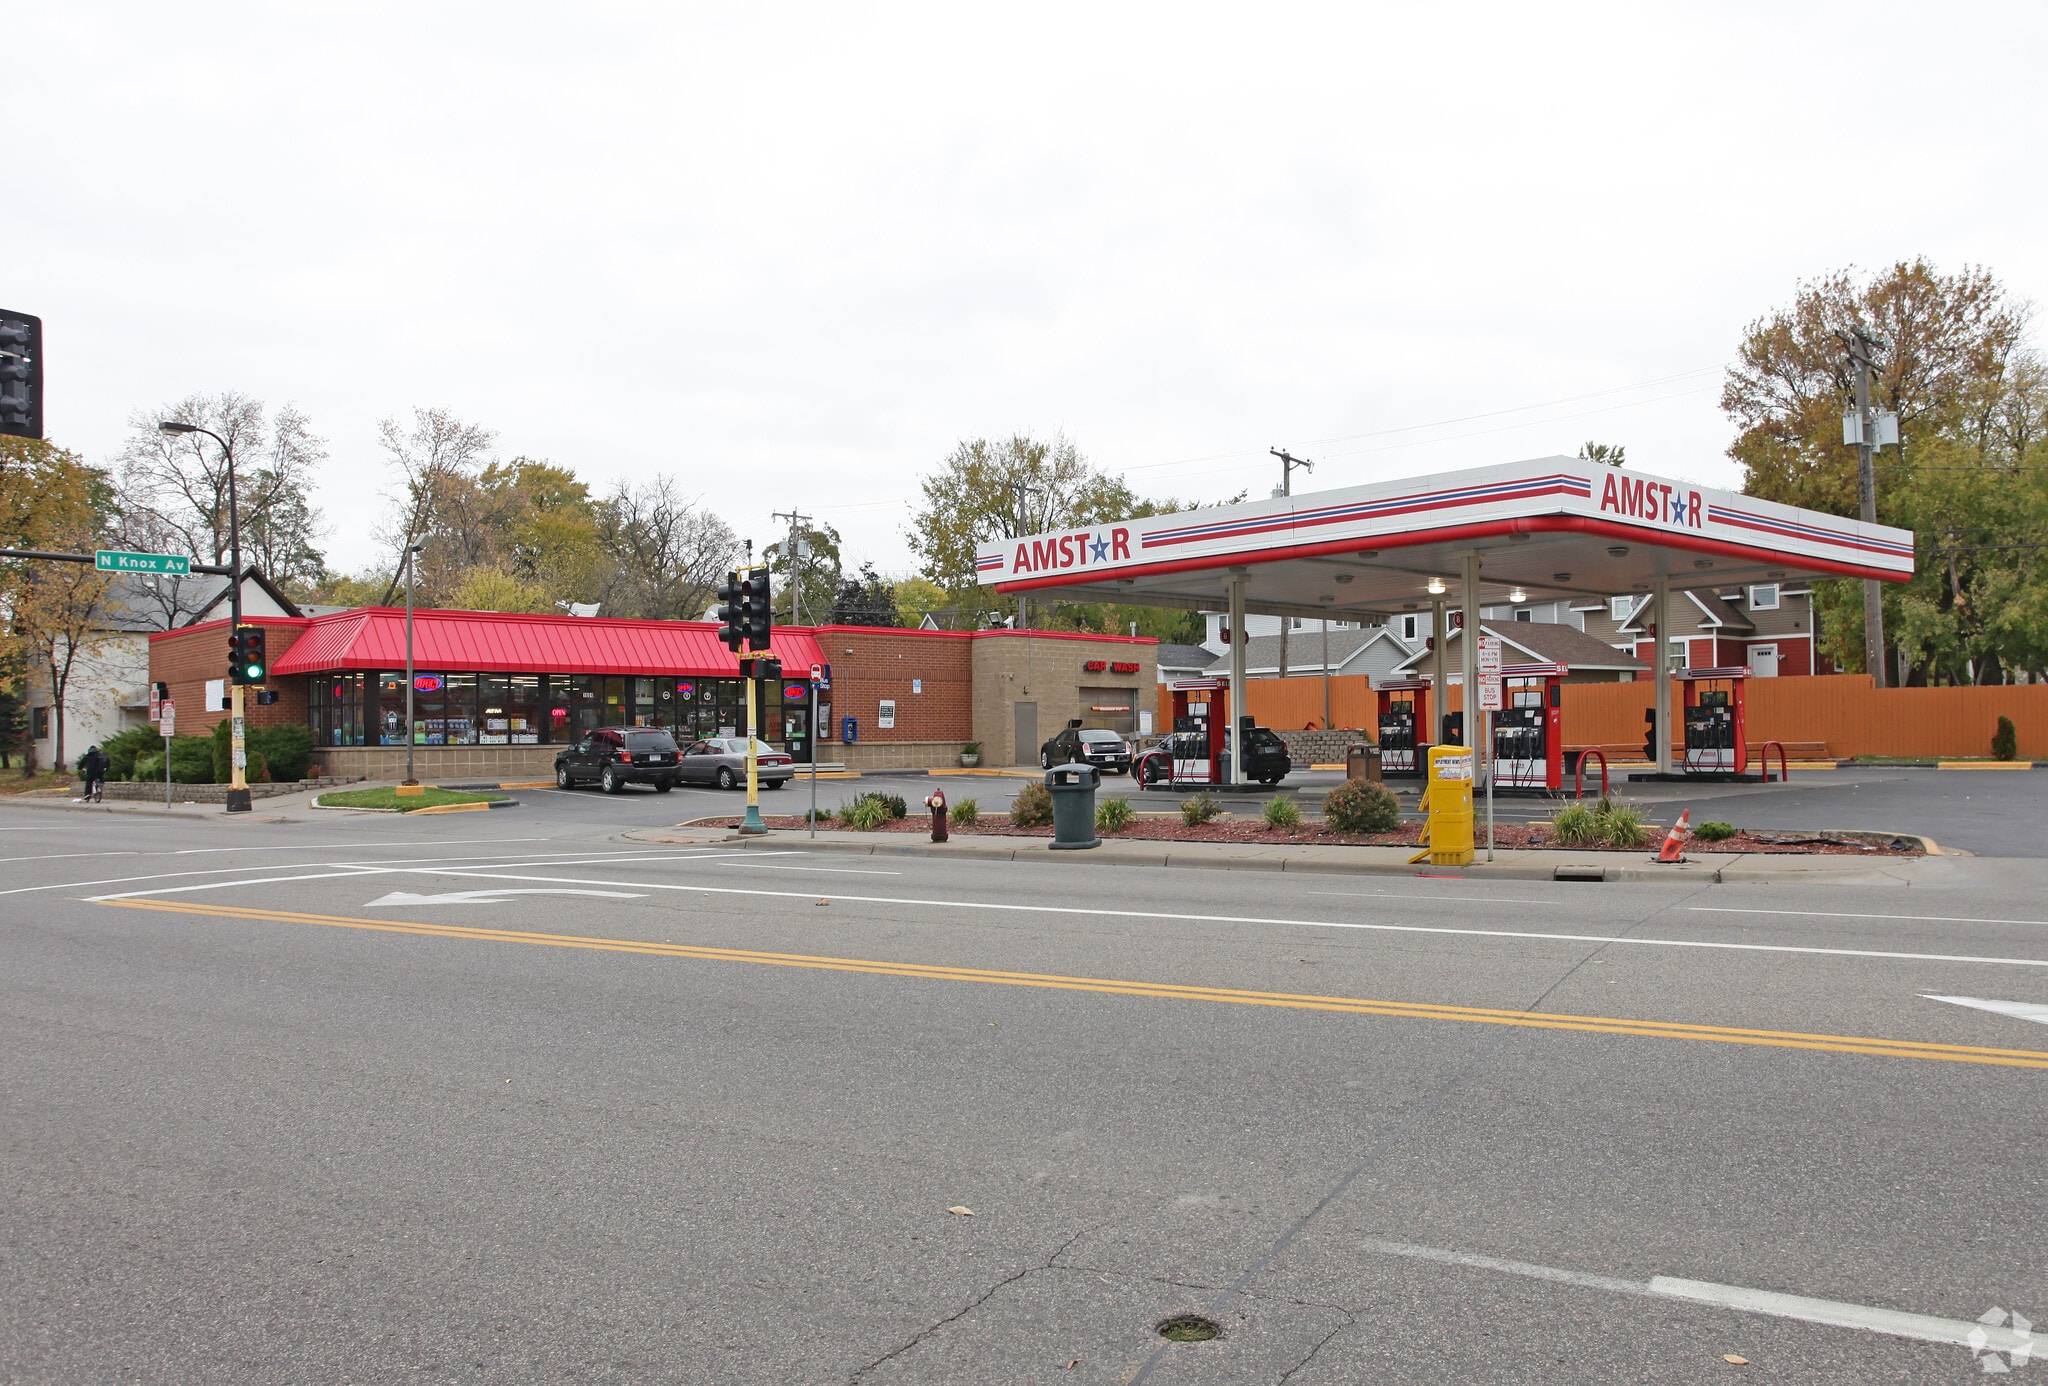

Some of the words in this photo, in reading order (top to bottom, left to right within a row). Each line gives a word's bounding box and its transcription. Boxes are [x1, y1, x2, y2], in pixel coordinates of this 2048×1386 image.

[101, 555, 111, 566] N
[119, 556, 157, 569] Knox
[165, 560, 184, 570] Av
[1087, 660, 1107, 671] CAR
[1113, 662, 1140, 673] WASH
[551, 708, 567, 716] OPEN
